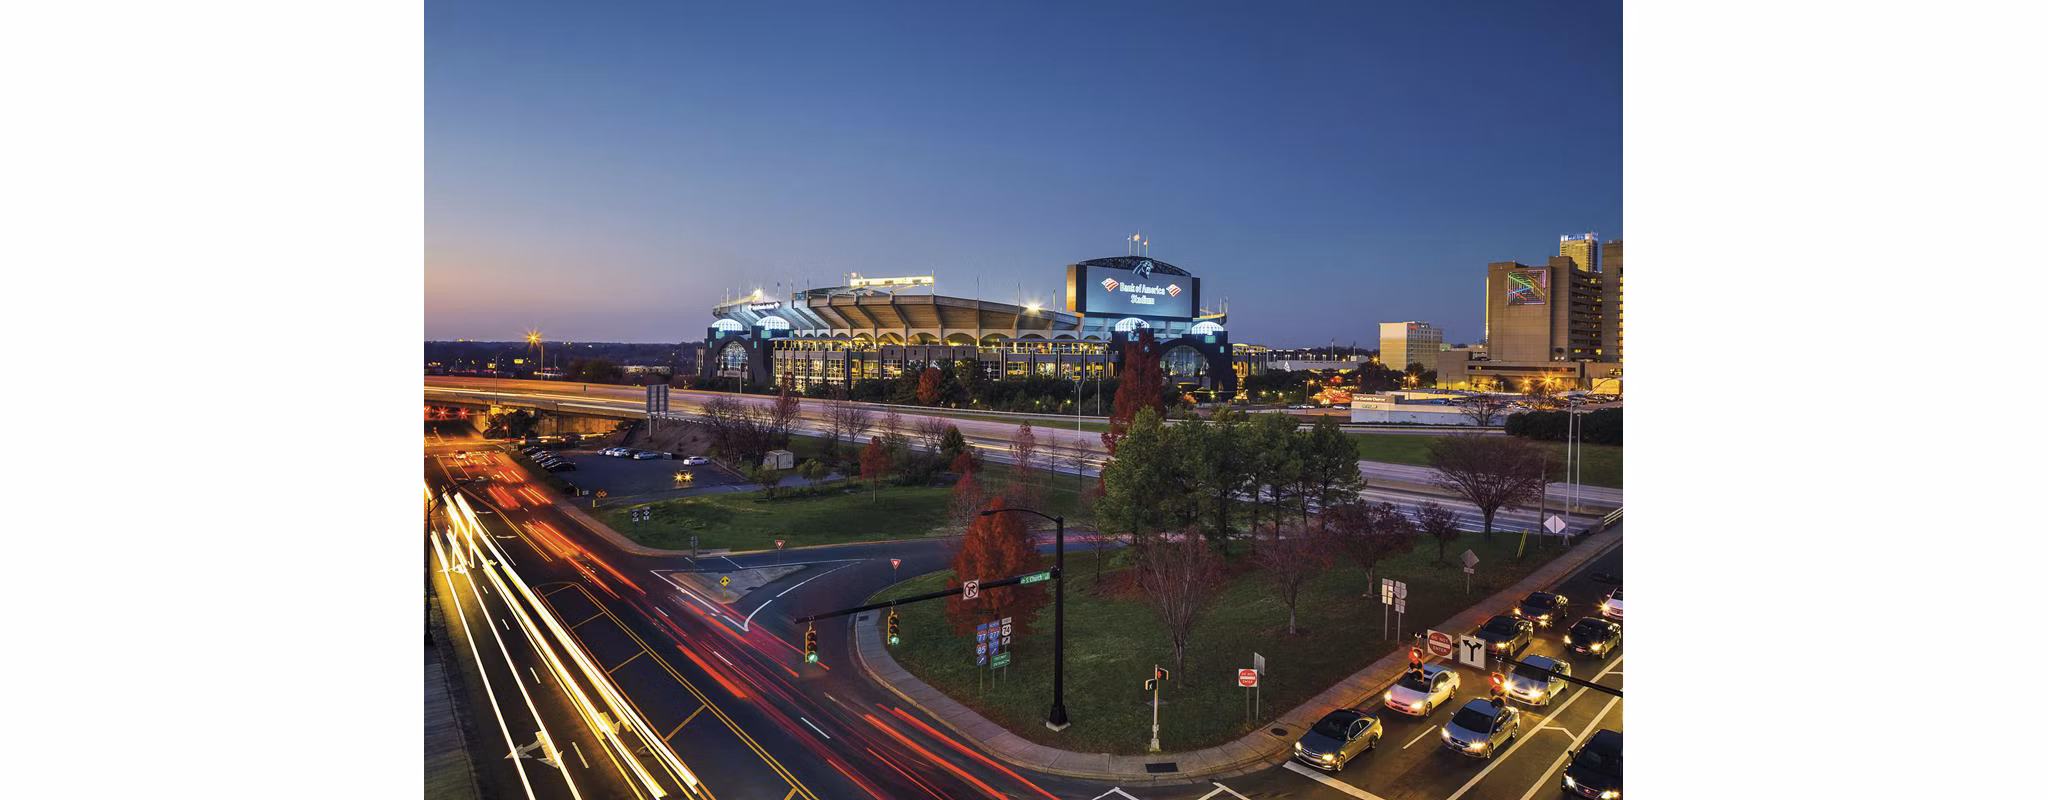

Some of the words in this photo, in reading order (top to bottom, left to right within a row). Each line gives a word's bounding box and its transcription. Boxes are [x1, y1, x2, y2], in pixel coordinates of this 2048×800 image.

[1120, 282, 1135, 293] Bank
[1136, 284, 1142, 293] of
[1142, 284, 1165, 295] America
[1131, 294, 1155, 304] Stadium
[978, 634, 986, 642] 77
[990, 631, 999, 639] 277
[1433, 645, 1447, 653] ENTER
